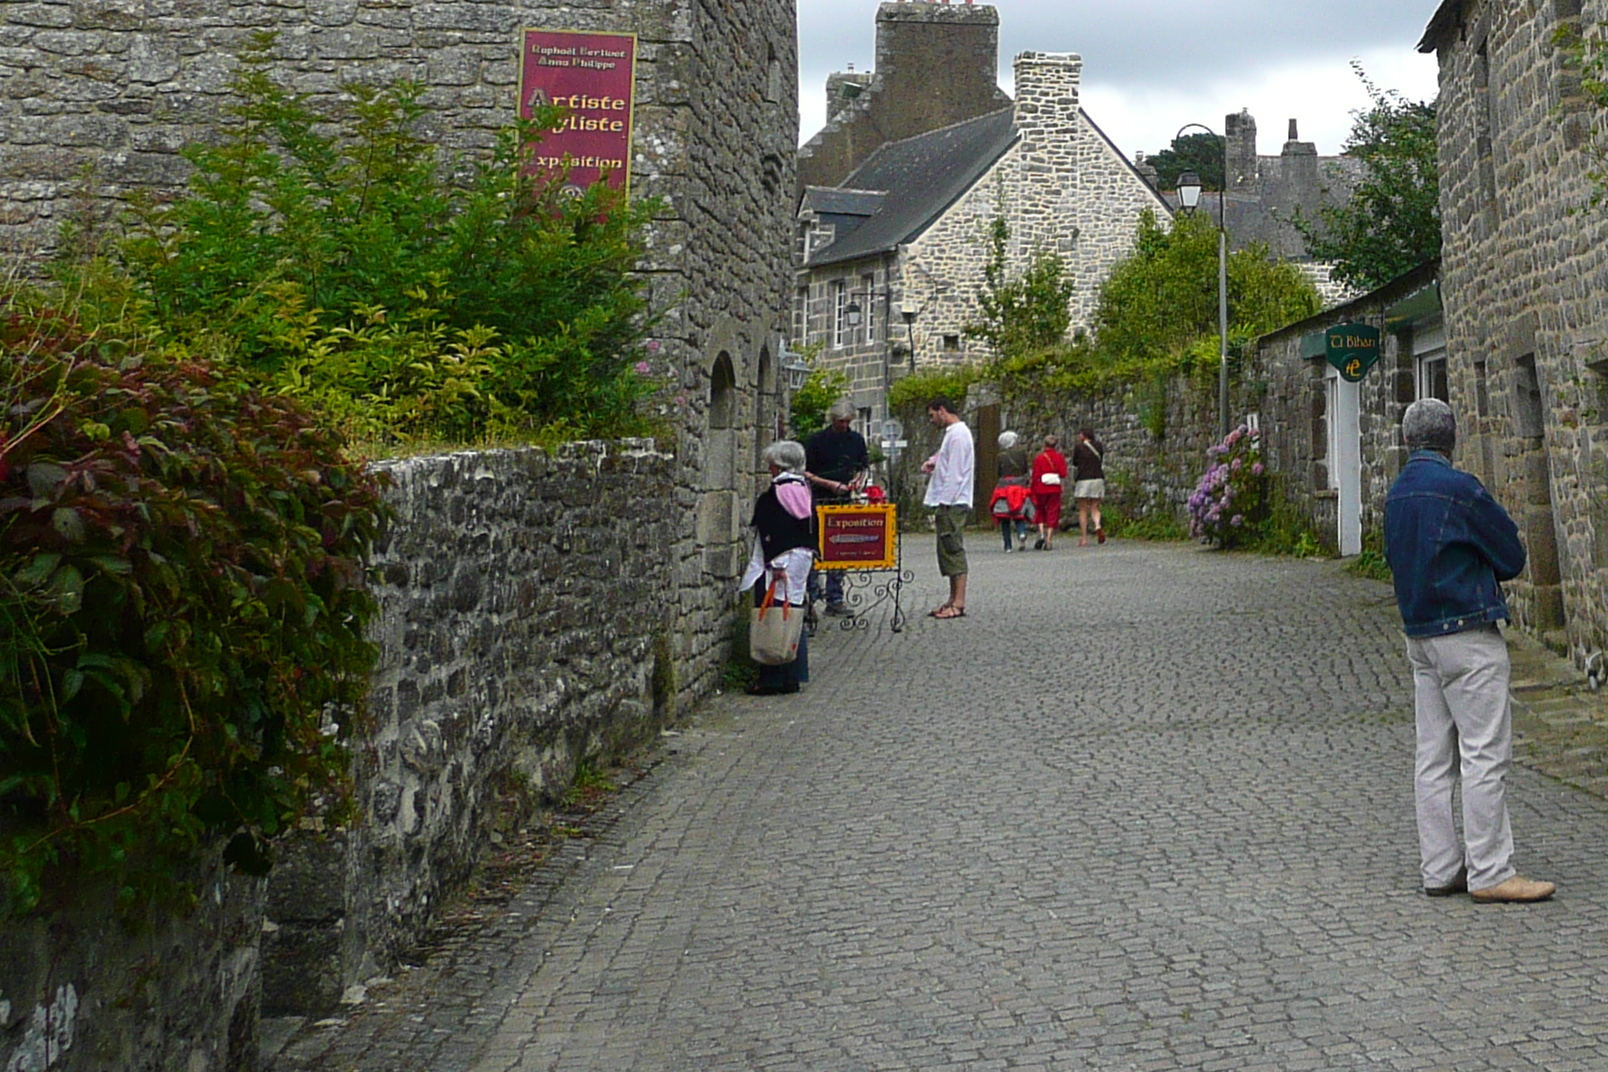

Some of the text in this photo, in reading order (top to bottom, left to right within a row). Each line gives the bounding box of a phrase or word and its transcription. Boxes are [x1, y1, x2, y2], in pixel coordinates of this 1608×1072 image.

[528, 88, 625, 110] Artiste
[1346, 335, 1376, 348] Bihan
[828, 516, 884, 530] Exposition
